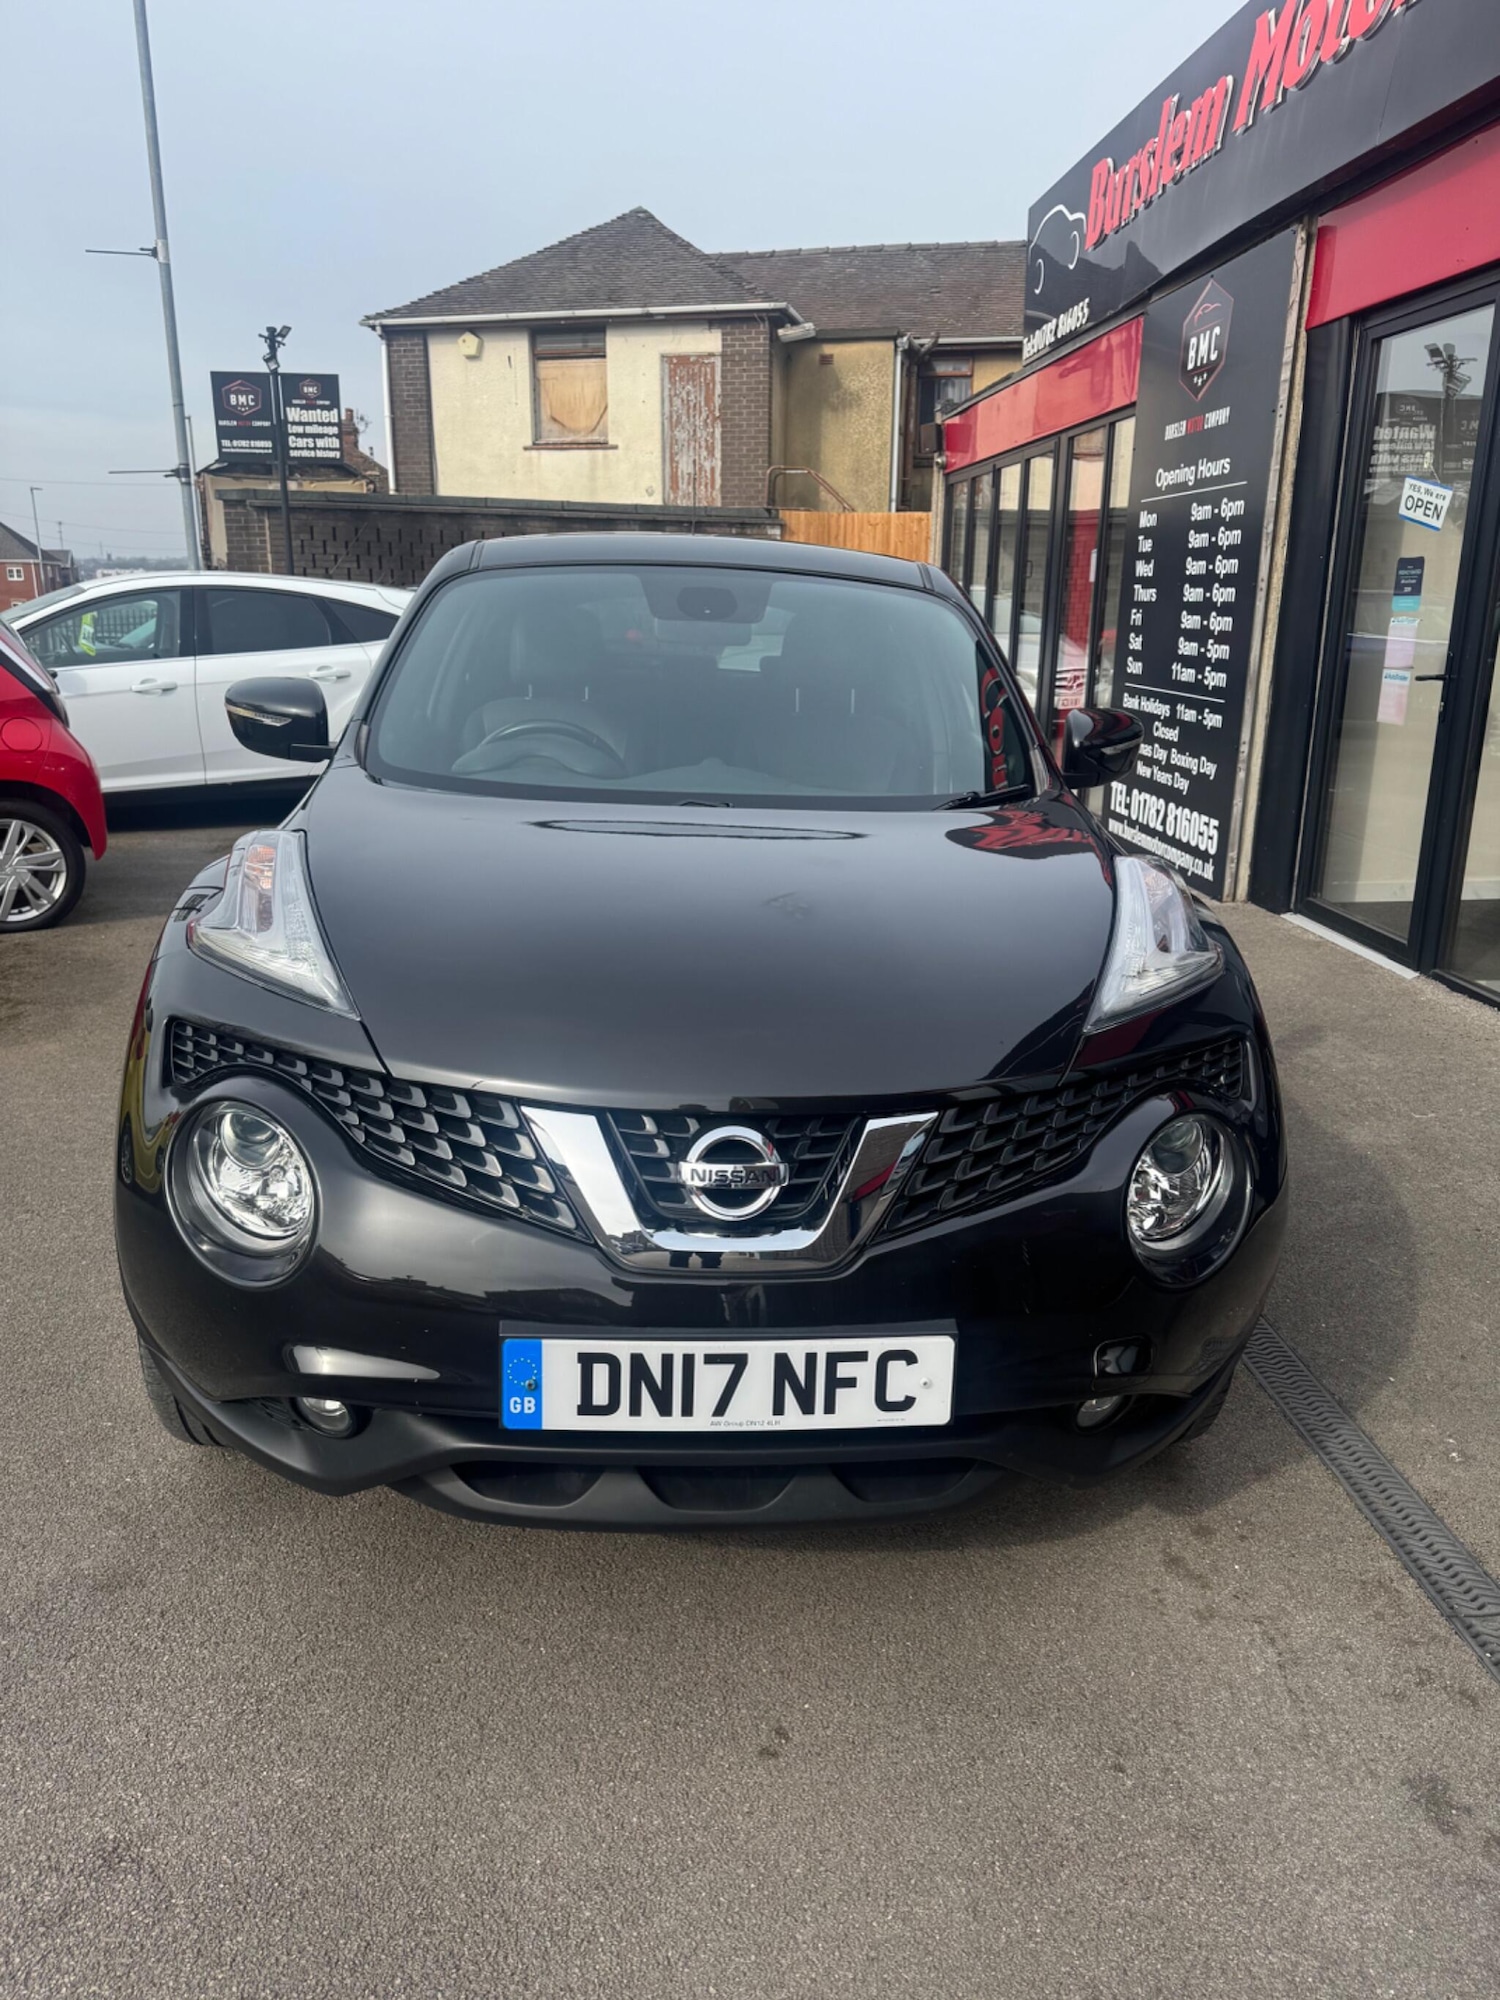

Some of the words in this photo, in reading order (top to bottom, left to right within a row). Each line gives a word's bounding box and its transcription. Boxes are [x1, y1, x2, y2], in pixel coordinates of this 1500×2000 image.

[1085, 75, 1233, 251] Burslem
[1057, 297, 1090, 339] 816055
[1187, 325, 1221, 372] BMC
[230, 394, 255, 406] BMC
[286, 407, 338, 422] Wanted
[1204, 406, 1230, 430] COMPANY
[287, 424, 304, 433] Low
[305, 424, 338, 435] mileage
[288, 436, 314, 448] Cars
[314, 436, 340, 449] with
[289, 449, 315, 457] service
[316, 450, 340, 459] history
[1156, 464, 1195, 490] Opening
[1197, 457, 1231, 479] Hours
[1408, 482, 1422, 495] YES,
[1424, 487, 1434, 497] We
[1435, 492, 1446, 501] are
[1139, 511, 1157, 528] Mon
[1190, 502, 1212, 521] 9am
[1221, 498, 1245, 522] 6pm
[1405, 495, 1443, 520] OPEN
[1138, 536, 1153, 552] Tue
[1188, 530, 1209, 548] 9am
[1218, 526, 1242, 550] 6pm
[1136, 559, 1154, 577] Wed
[1185, 556, 1206, 575] 9am
[1215, 555, 1239, 579] 6pm
[1133, 584, 1157, 602] Thurs
[1183, 584, 1204, 602] 9am
[1212, 582, 1236, 607] 6pm
[1130, 609, 1142, 626] Fri
[1180, 610, 1201, 629] 9am
[1209, 611, 1233, 635] 6pm
[1128, 633, 1142, 651] Sat
[1178, 637, 1198, 656] 9am
[1206, 639, 1230, 663] 5pm
[1126, 656, 1142, 675] Sun
[1172, 662, 1196, 683] 11am
[1203, 665, 1227, 690] 5pm
[1123, 692, 1140, 710] Bank
[1140, 696, 1171, 720] Holidays
[1176, 703, 1197, 723] 11am
[1203, 708, 1223, 730] 5pm
[1153, 721, 1179, 742] Closed
[1153, 743, 1168, 765] Day
[1170, 748, 1198, 775] Boxing
[1199, 756, 1217, 780] Day
[1136, 760, 1152, 778] New
[1152, 765, 1173, 786] Years
[1173, 772, 1190, 795] Day
[1110, 781, 1130, 817] TEL:
[1130, 788, 1165, 832] 01782
[1166, 802, 1219, 855] 816055
[691, 1168, 777, 1184] NISSAN
[577, 1352, 748, 1417] DN17
[772, 1349, 919, 1416] NFC
[509, 1397, 536, 1414] GB
